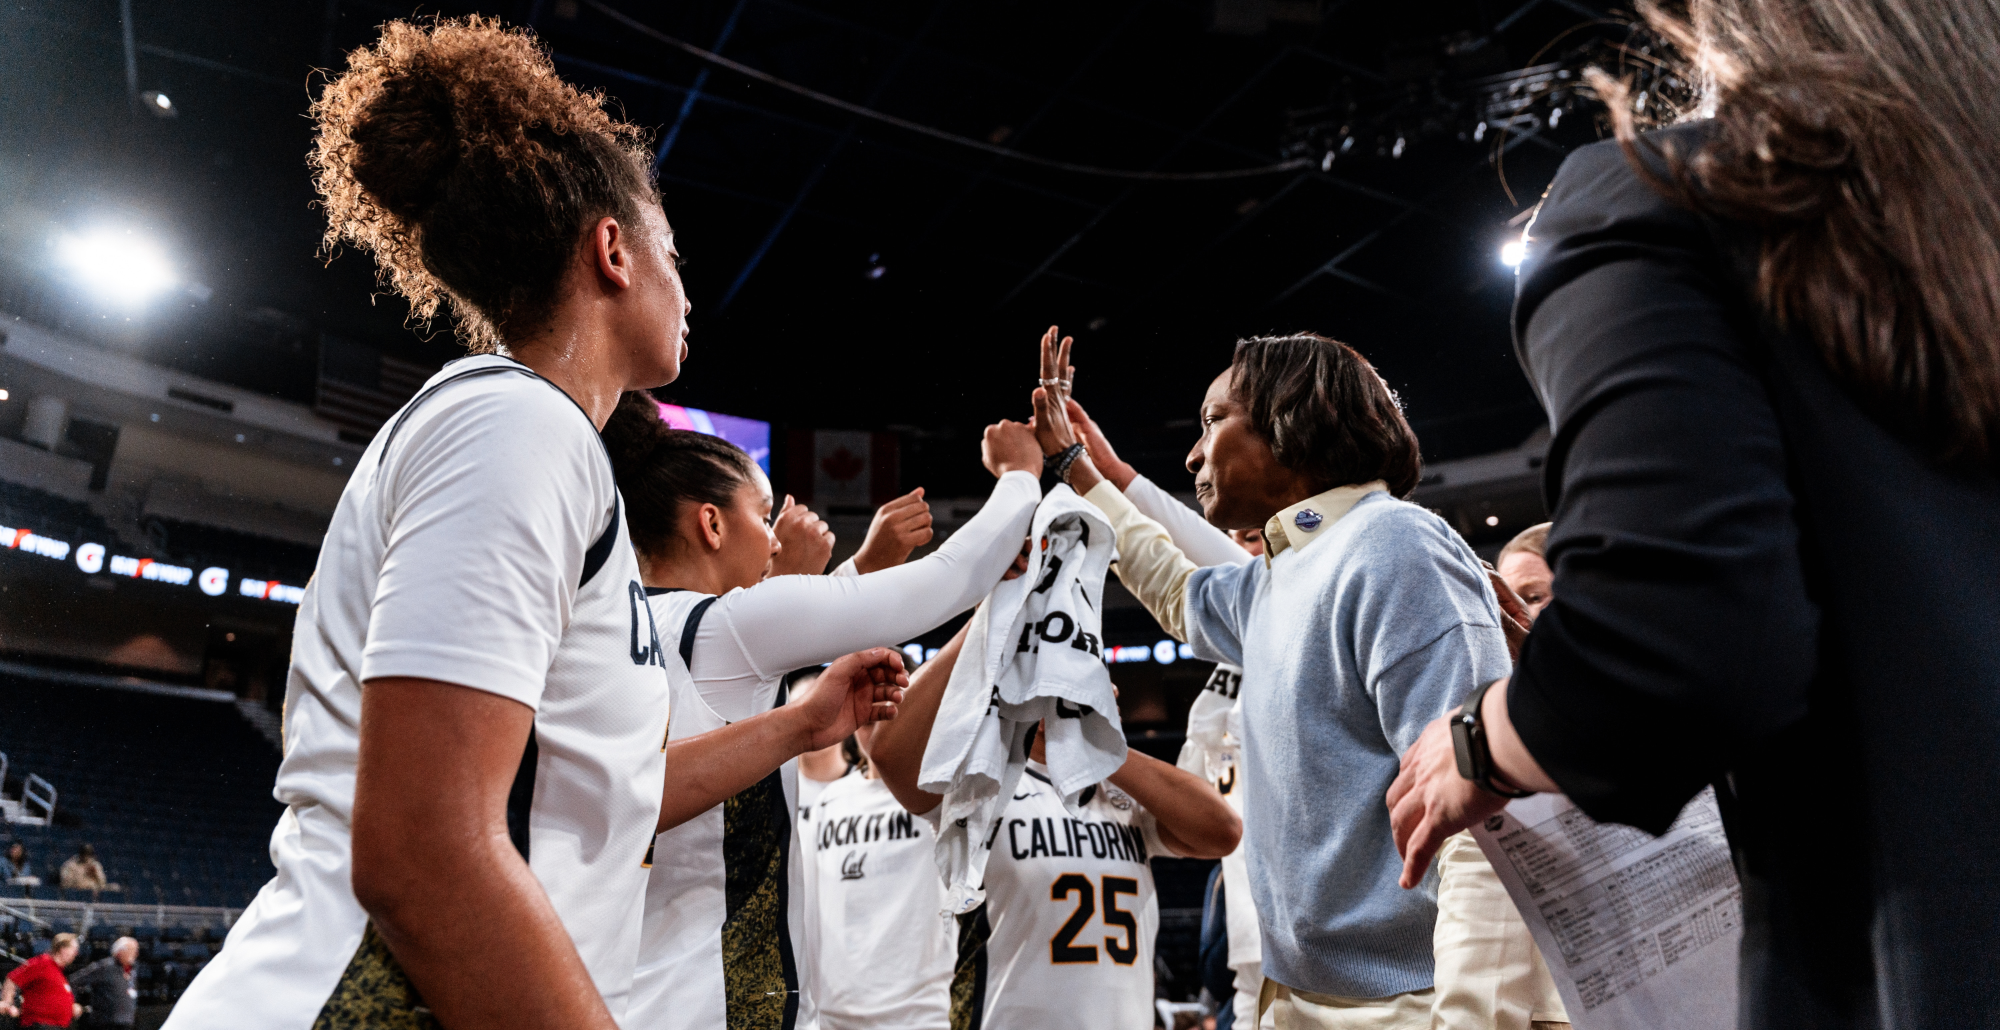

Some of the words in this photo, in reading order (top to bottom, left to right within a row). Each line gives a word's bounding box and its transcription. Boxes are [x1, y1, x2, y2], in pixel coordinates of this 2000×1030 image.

[864, 812, 885, 843] IT
[888, 809, 920, 840] IN.
[841, 849, 868, 881] Cal
[1049, 872, 1139, 968] 25
